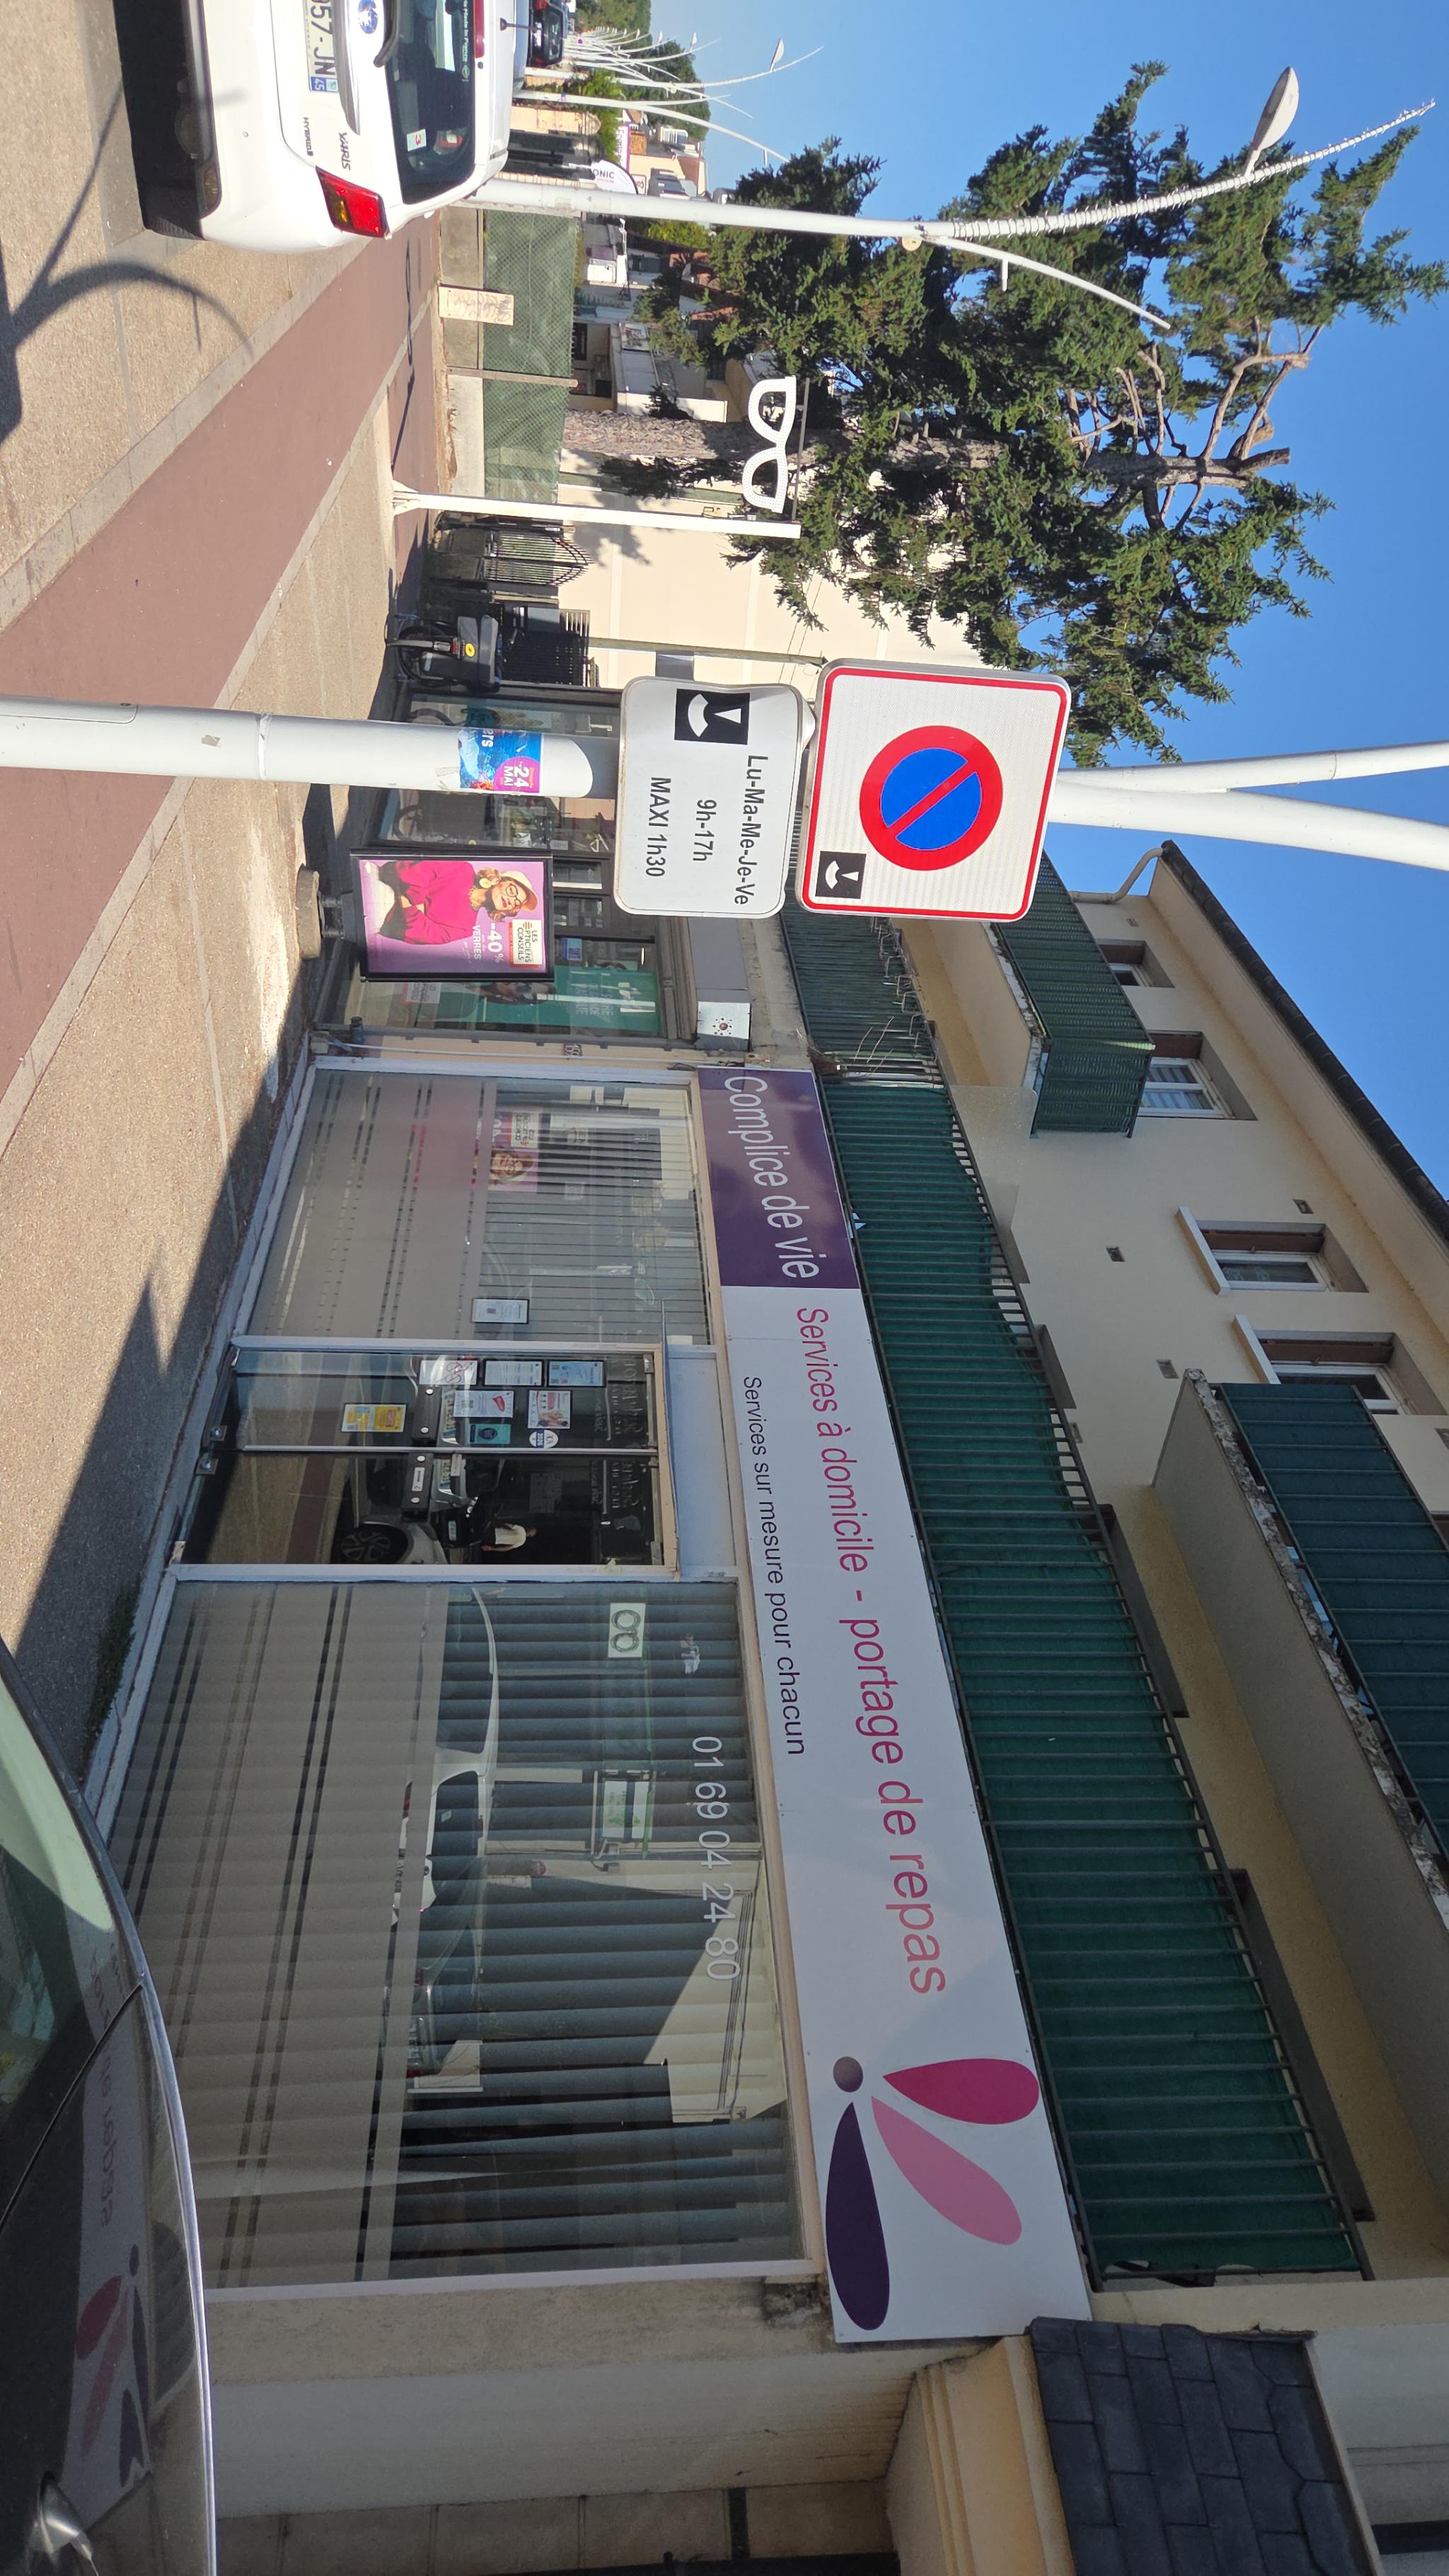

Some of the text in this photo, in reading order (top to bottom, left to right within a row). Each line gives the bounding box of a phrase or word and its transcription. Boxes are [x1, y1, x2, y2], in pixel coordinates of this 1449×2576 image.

[311, 0, 336, 91] 57-JN 45
[339, 132, 351, 171] YARIS
[504, 766, 514, 786] MAI
[514, 766, 529, 788] 24
[645, 777, 671, 877] MAXI 1h30
[693, 799, 717, 861] 9h-17h
[734, 755, 768, 905] Lu-Ma-Me-Je-Ve
[472, 924, 482, 960] VERRES
[724, 1076, 827, 1278] Complice de vie
[796, 1308, 838, 1412] Services
[816, 1422, 850, 1437] à
[820, 1448, 874, 1572] domicile
[743, 1376, 804, 1755] Services sur mesure pour chacun
[838, 1618, 903, 1764] portage
[692, 1736, 740, 1980] 01 69 04 24 80
[877, 1781, 923, 1835] de
[885, 1853, 946, 1994] repas
